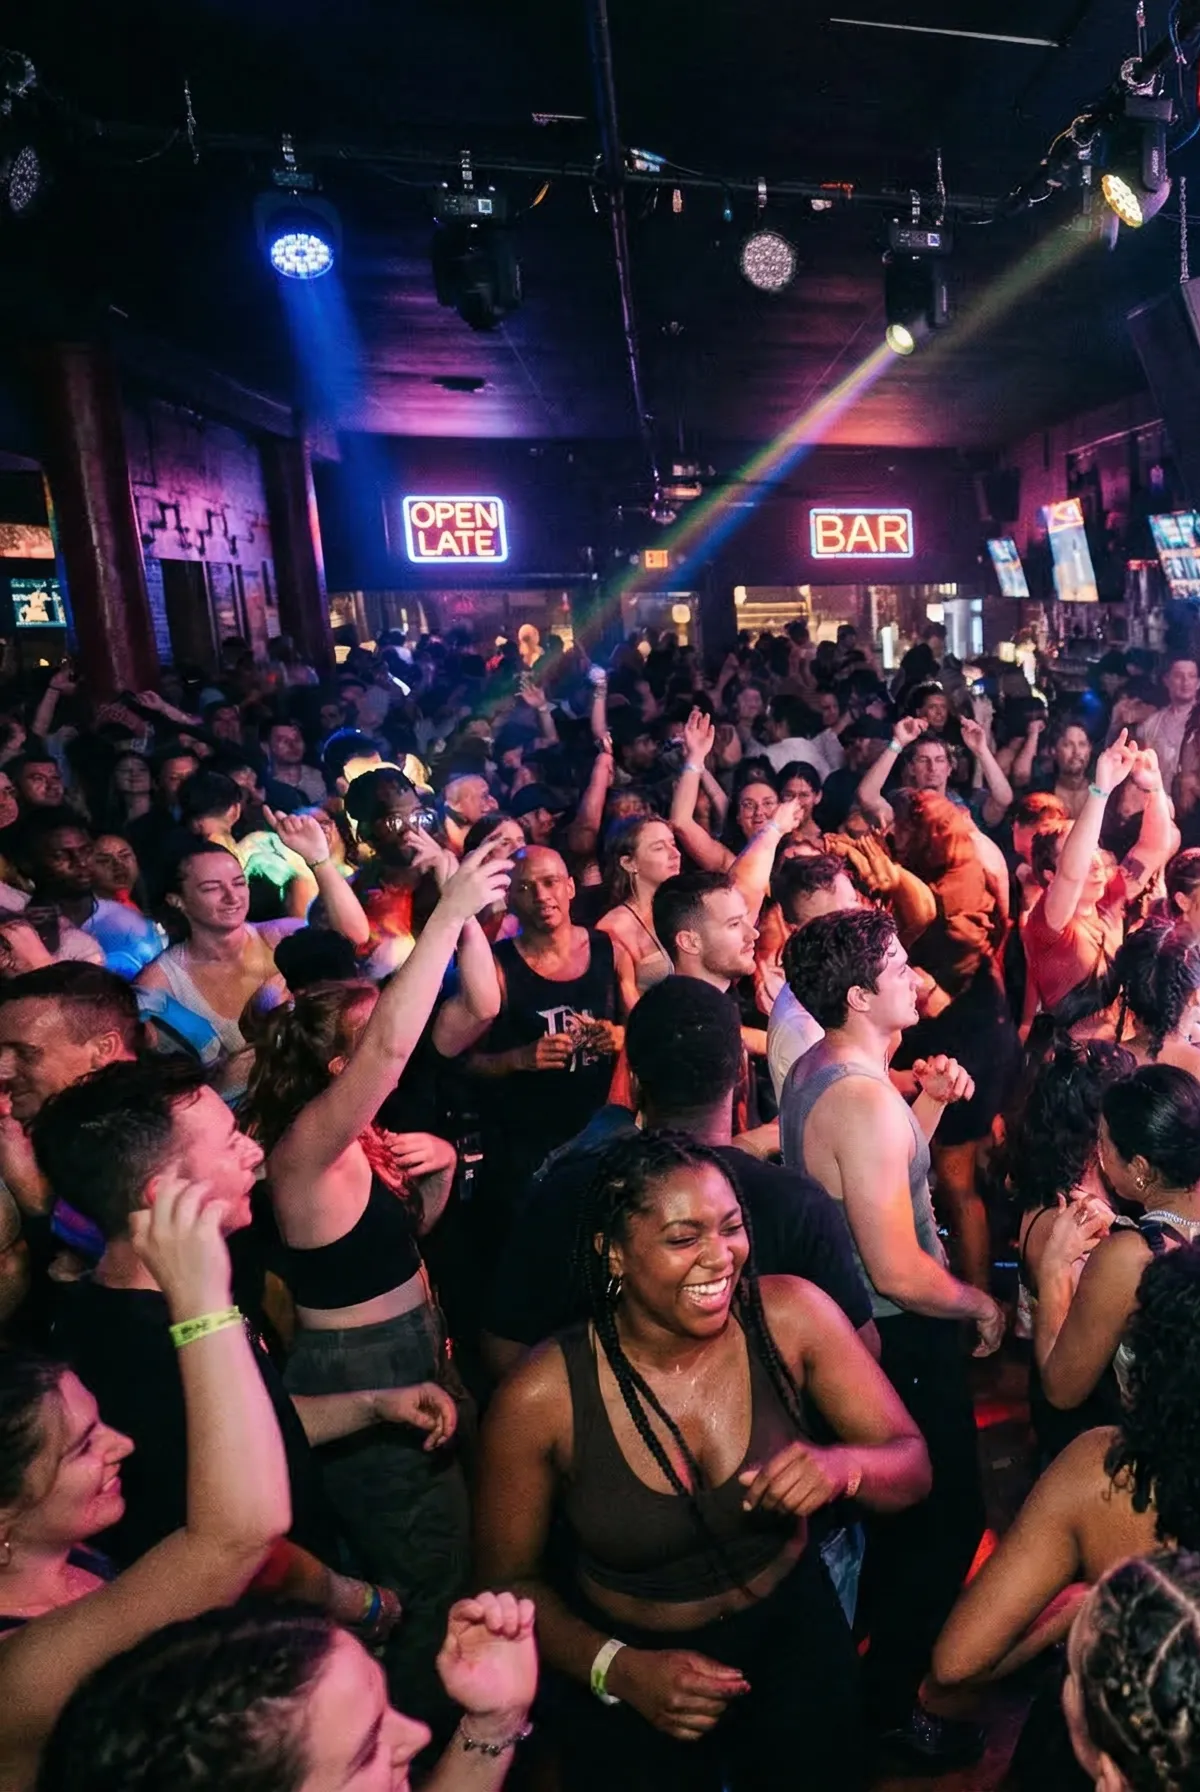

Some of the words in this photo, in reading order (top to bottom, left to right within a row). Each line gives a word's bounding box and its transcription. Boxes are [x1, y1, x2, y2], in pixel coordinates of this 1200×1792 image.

[411, 502, 498, 529] OPEN
[418, 530, 495, 555] LATE
[816, 515, 908, 553] BAR
